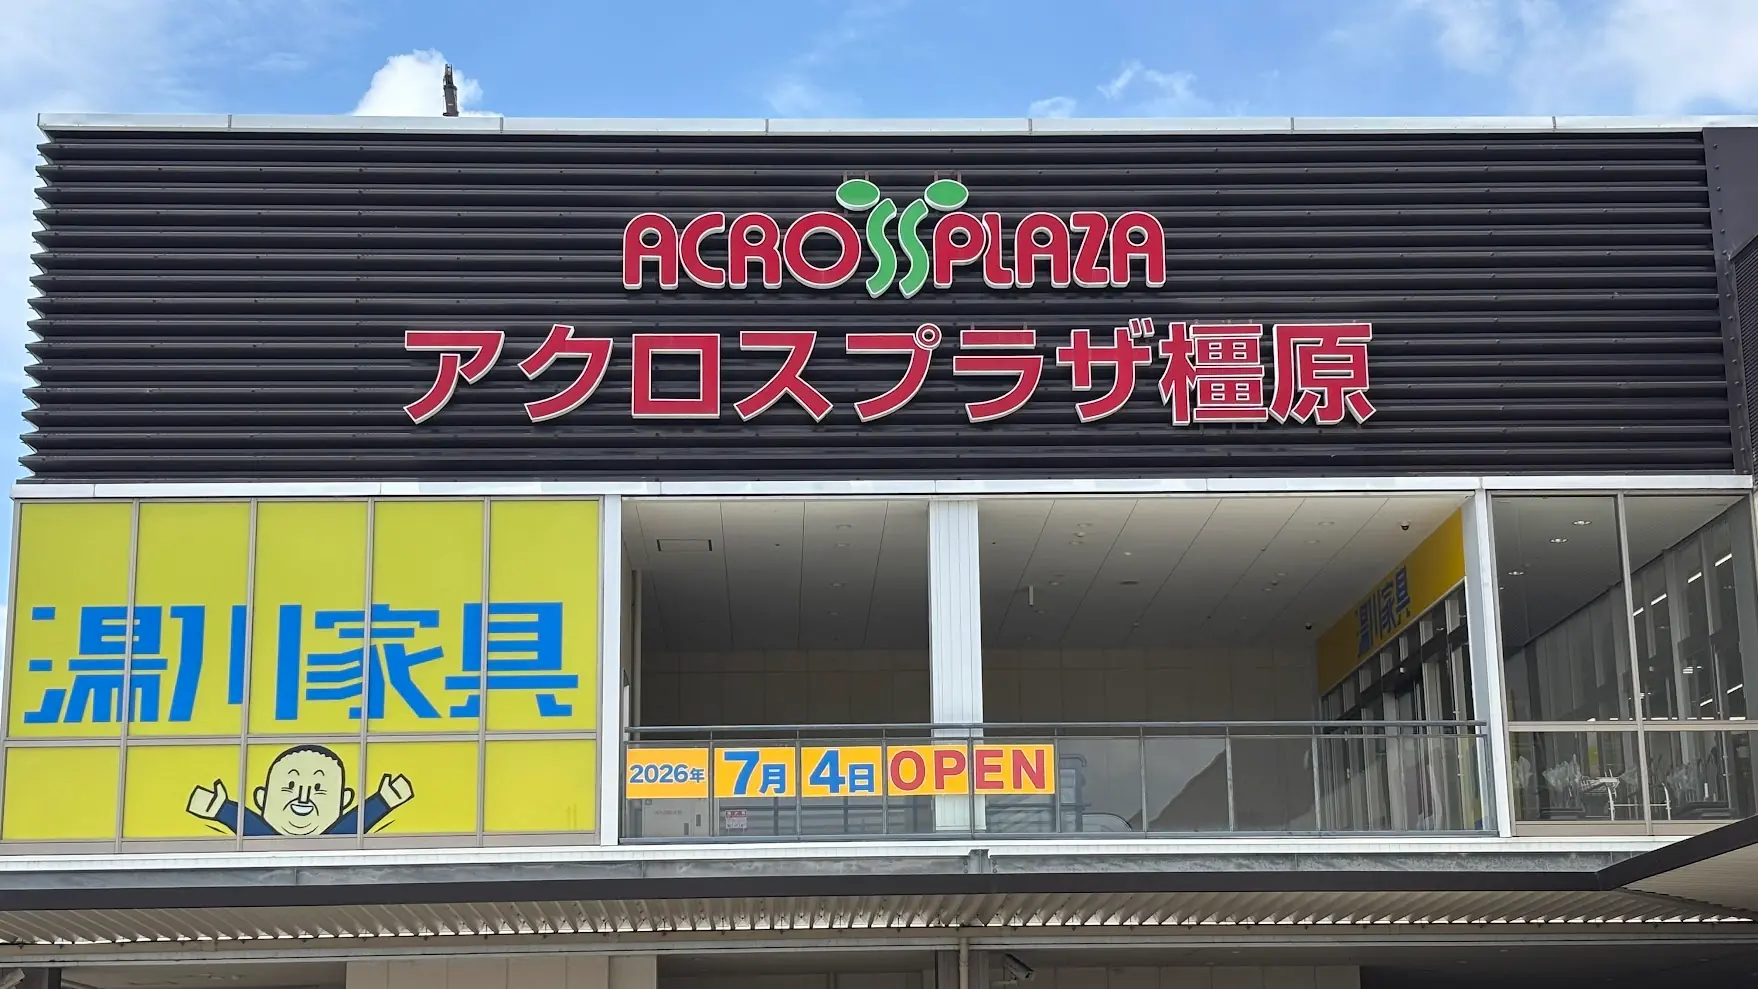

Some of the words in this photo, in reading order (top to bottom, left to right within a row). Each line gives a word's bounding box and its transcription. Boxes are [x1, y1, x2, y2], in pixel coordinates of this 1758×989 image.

[403, 317, 1377, 427] アクロスプラザ橿原
[24, 602, 579, 723] 湯川家具
[890, 749, 1046, 791] OPEN
